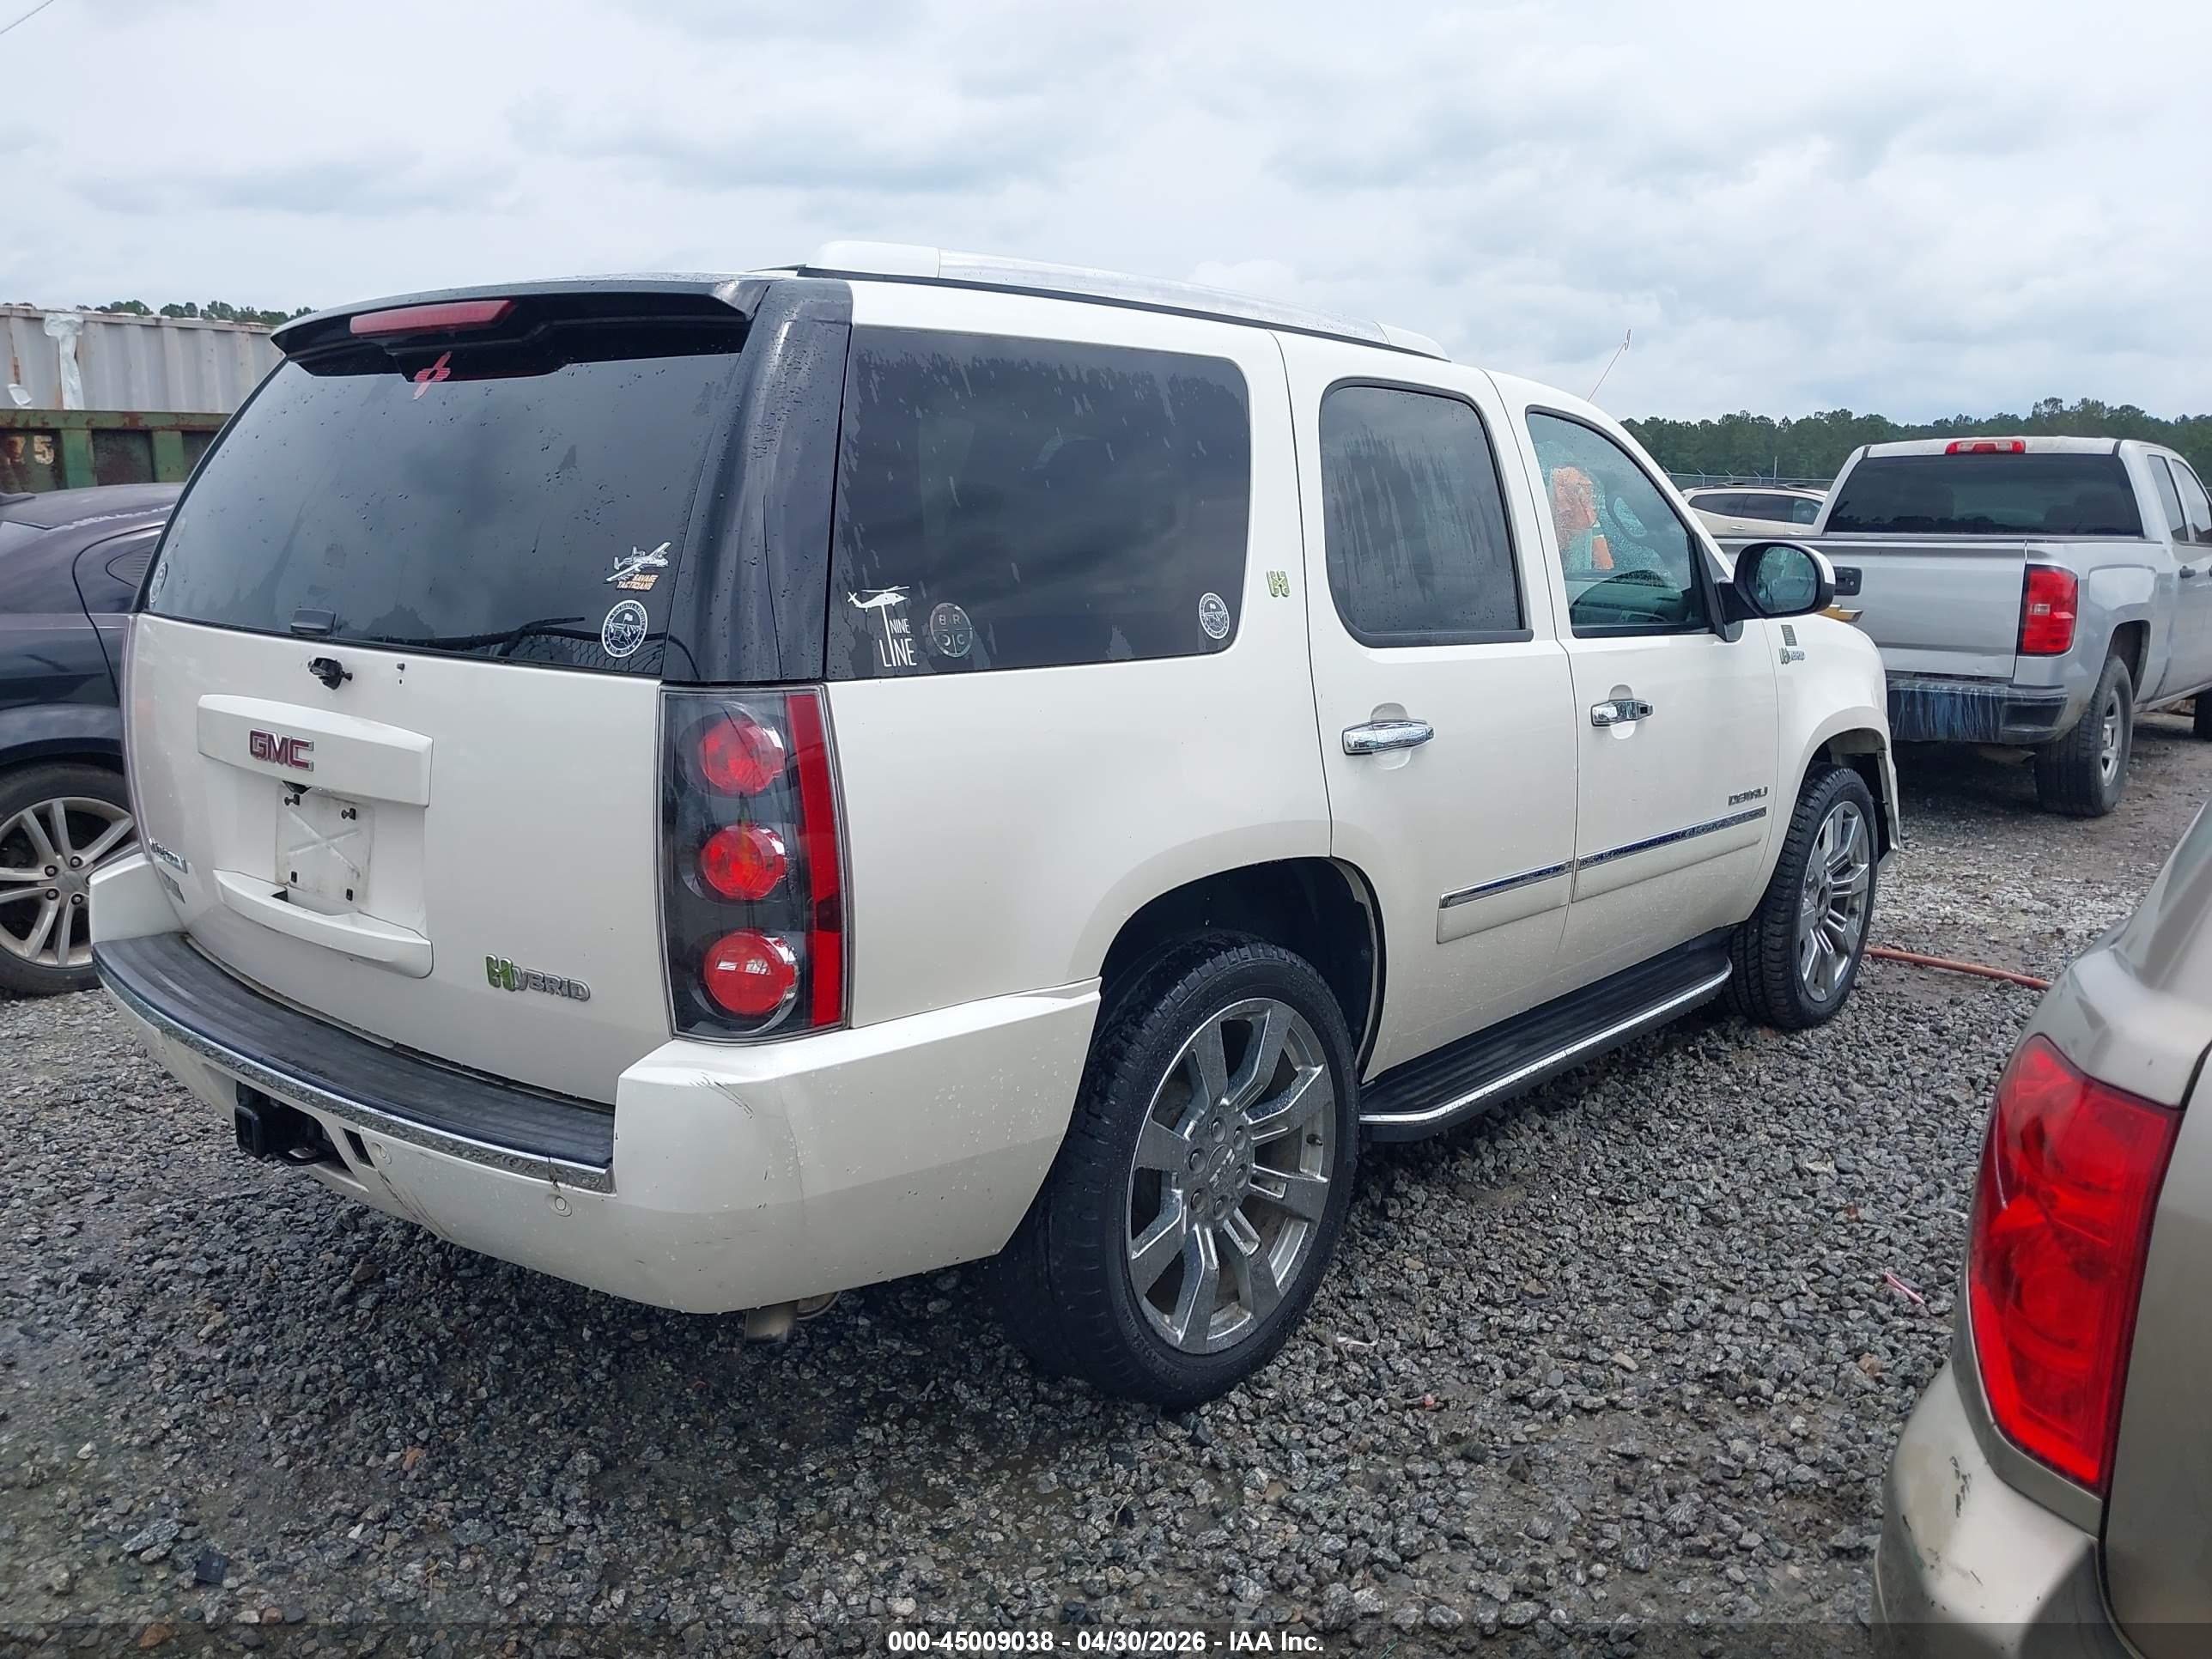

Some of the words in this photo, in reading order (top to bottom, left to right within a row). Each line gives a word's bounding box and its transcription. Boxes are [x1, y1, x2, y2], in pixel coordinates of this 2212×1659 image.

[889, 618, 911, 634] NINE
[878, 638, 917, 667] LINE
[250, 728, 314, 772] GMC
